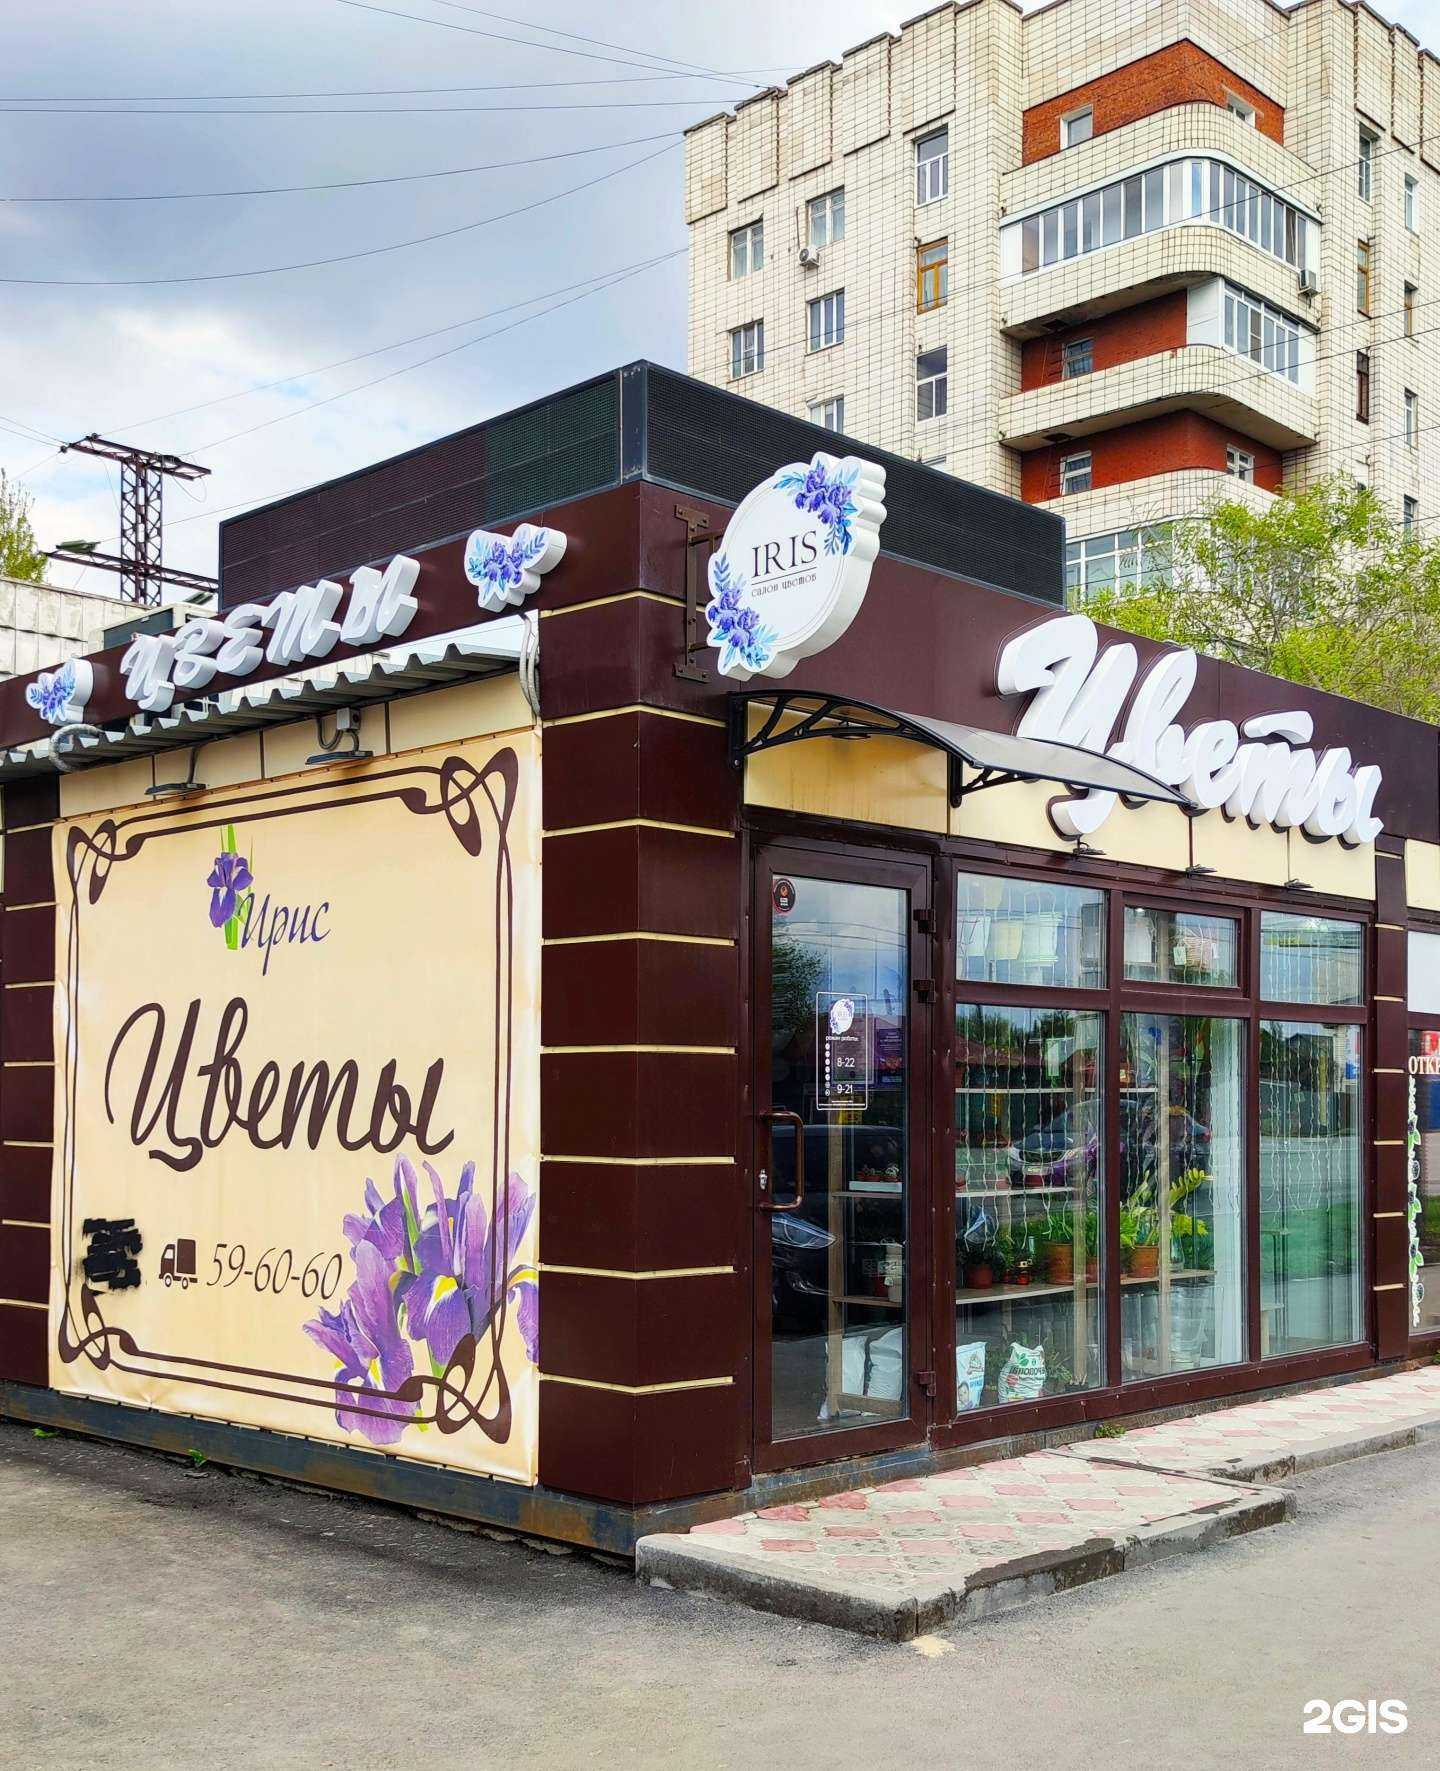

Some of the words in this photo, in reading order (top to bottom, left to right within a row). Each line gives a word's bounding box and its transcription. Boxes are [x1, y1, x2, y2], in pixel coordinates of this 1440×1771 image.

[751, 530, 817, 578] IRIS
[237, 893, 331, 976] Ирис
[104, 997, 454, 1172] Цветы
[836, 1057, 855, 1068] 8-22
[836, 1083, 853, 1094] 9-21
[206, 1243, 343, 1300] 59-60-60
